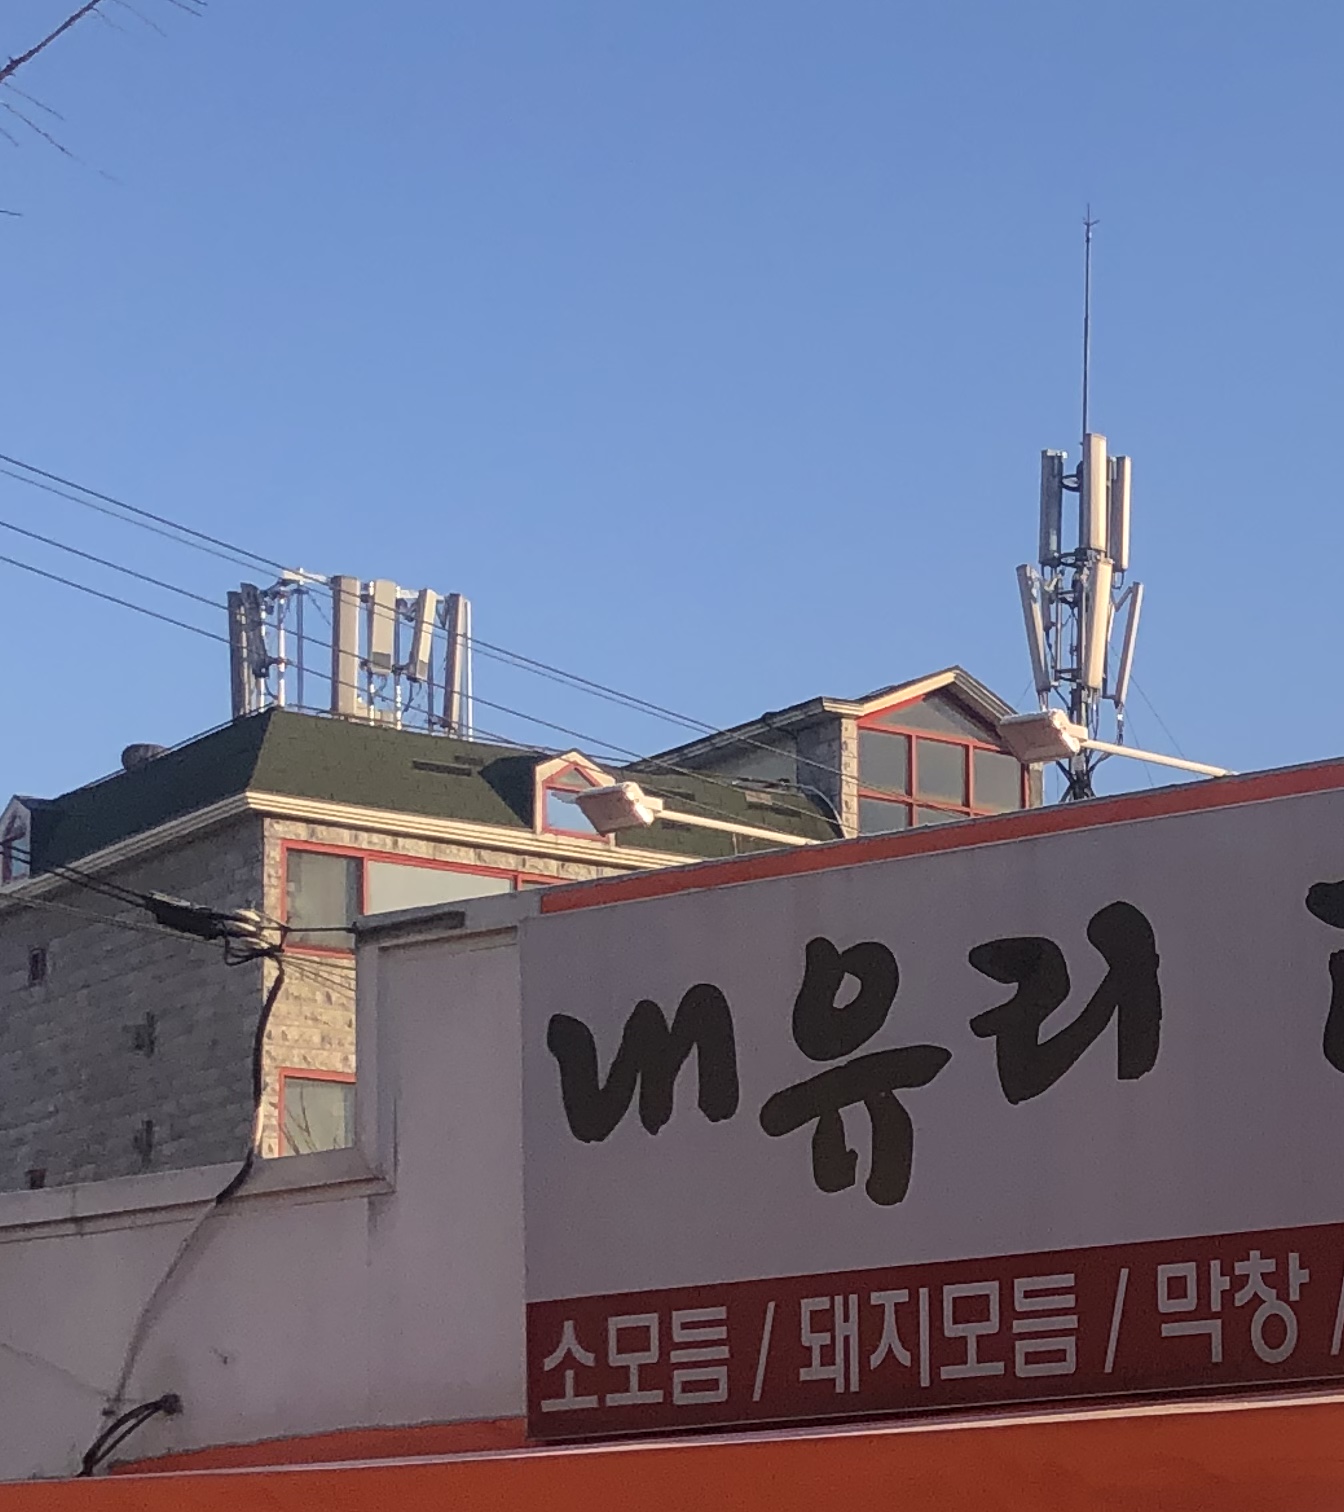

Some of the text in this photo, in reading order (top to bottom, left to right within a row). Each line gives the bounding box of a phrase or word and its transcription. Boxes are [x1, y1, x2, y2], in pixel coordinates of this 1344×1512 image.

[548, 901, 1160, 1205] 내유리
[540, 1303, 730, 1413] 소모듬
[799, 1276, 1078, 1386] 돼지모듬
[1157, 1250, 1309, 1365] 막창
